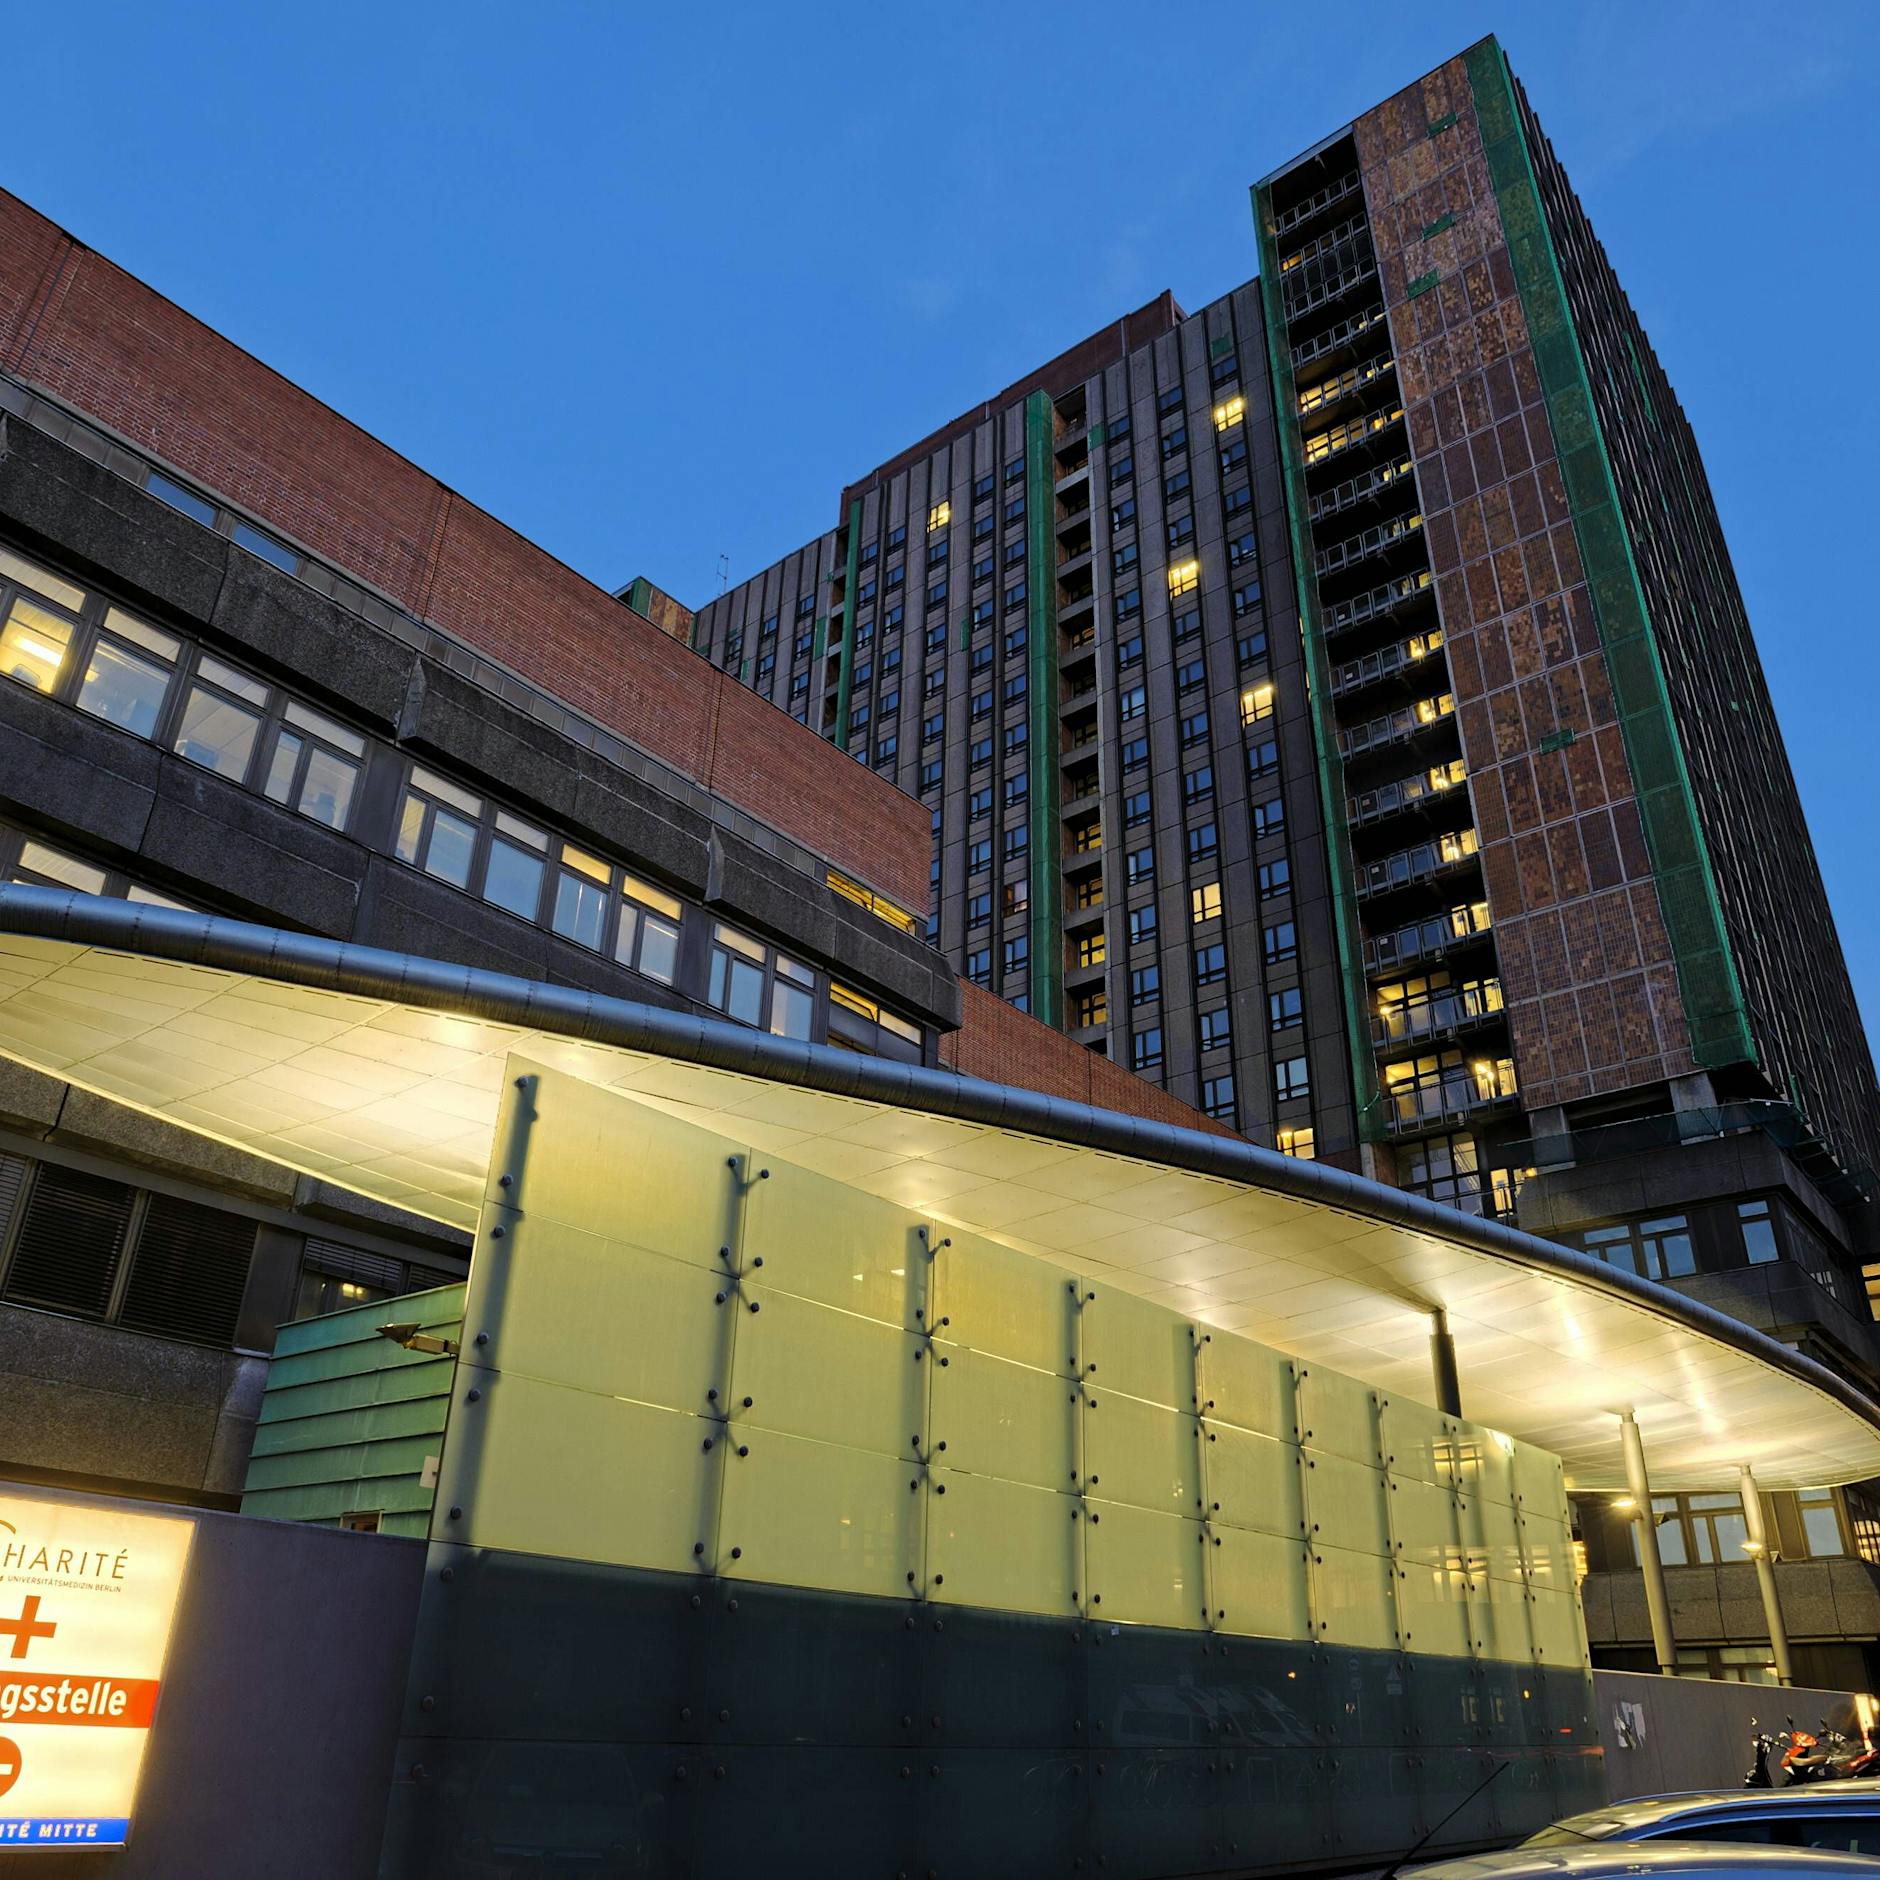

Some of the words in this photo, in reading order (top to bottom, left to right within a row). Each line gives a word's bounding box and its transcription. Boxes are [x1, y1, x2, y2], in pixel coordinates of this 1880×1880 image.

[8, 1576, 94, 1590] UNIVERSITÄTSMEDIZIN
[95, 1584, 122, 1593] BERLIN
[0, 1679, 127, 1719] gsstelle
[39, 1823, 98, 1838] MITTE
